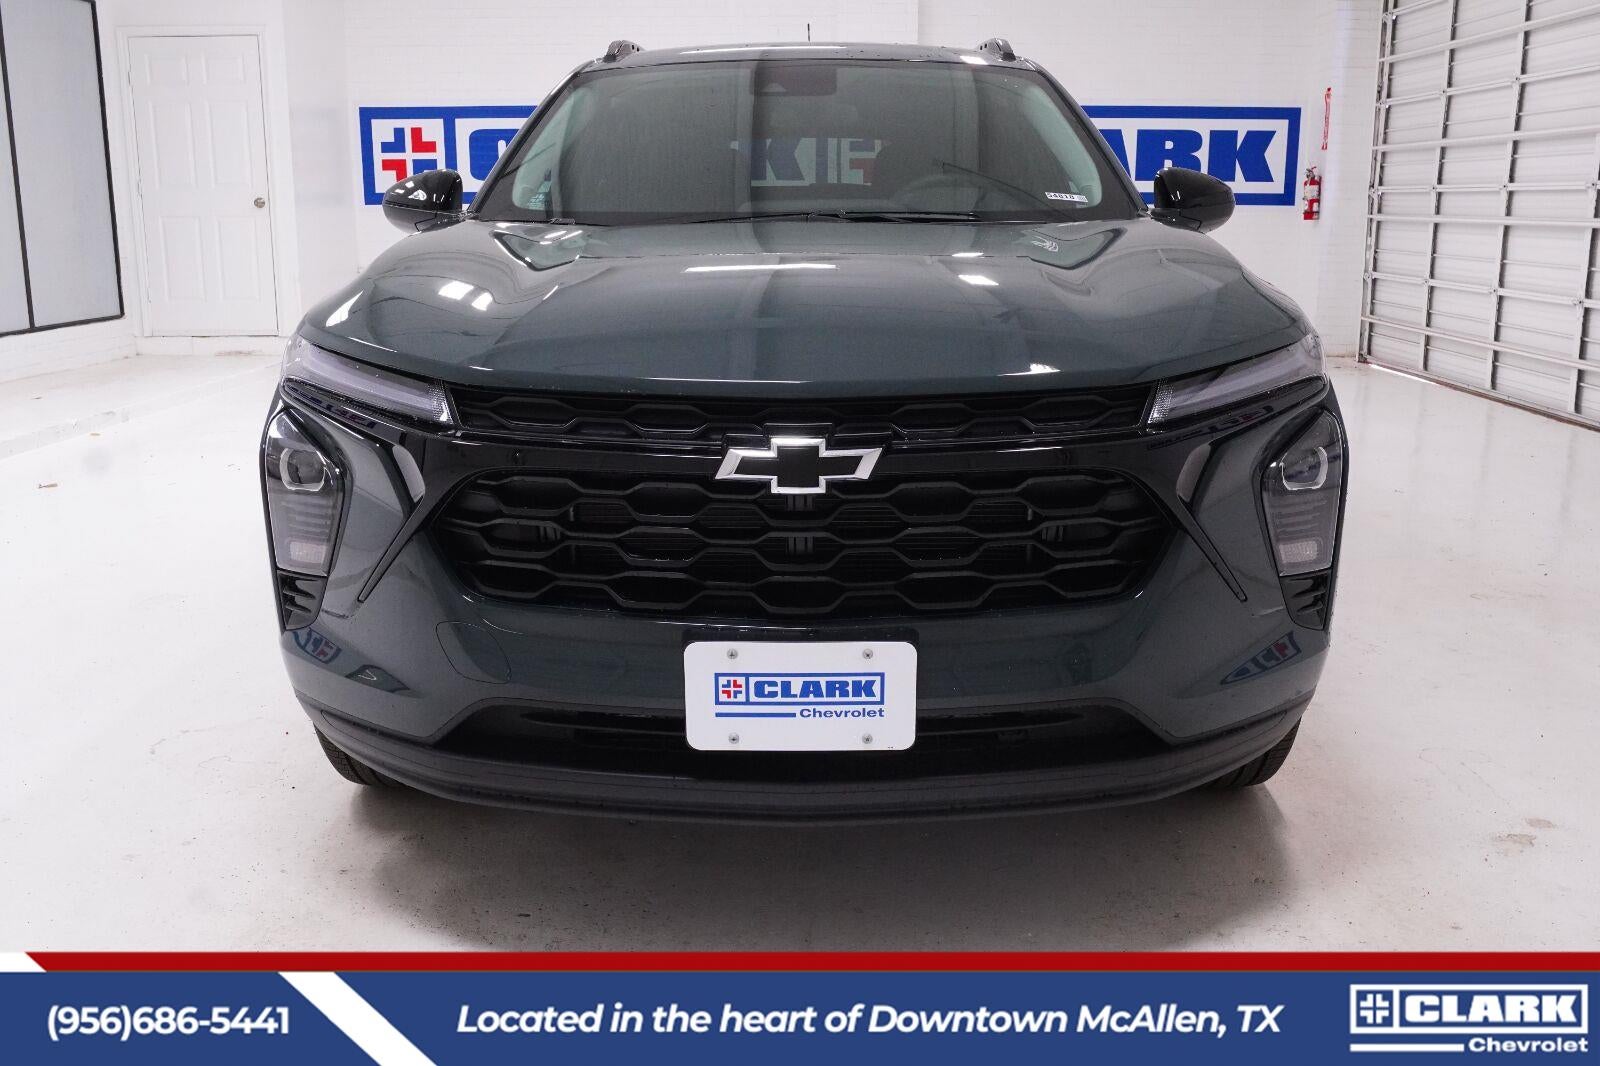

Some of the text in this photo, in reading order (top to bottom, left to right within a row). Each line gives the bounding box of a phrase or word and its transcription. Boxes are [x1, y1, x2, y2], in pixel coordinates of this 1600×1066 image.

[1098, 128, 1276, 183] RK
[754, 680, 876, 698] CLARK
[800, 708, 884, 718] Chevrolet
